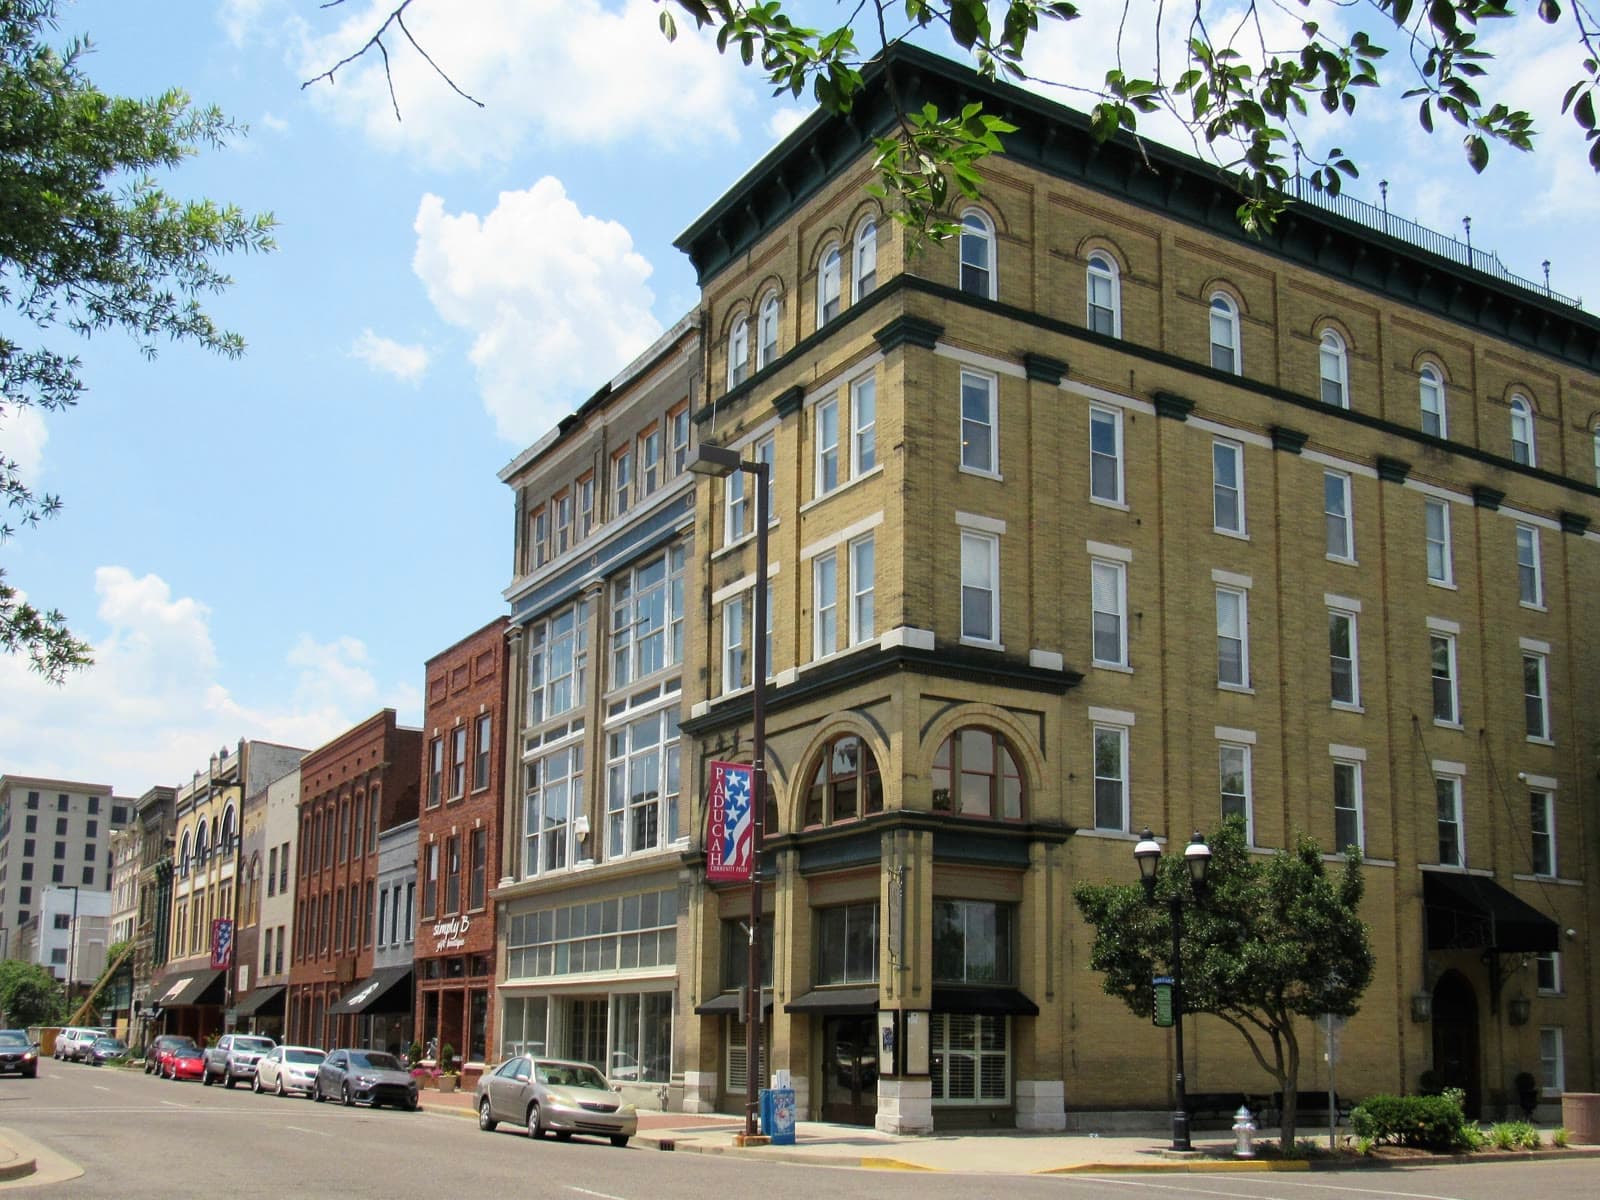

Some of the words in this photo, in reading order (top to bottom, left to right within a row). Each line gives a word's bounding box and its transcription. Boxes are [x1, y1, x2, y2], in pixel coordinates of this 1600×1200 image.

[711, 767, 725, 866] PADUCAH
[433, 917, 460, 940] simply
[460, 915, 470, 933] B
